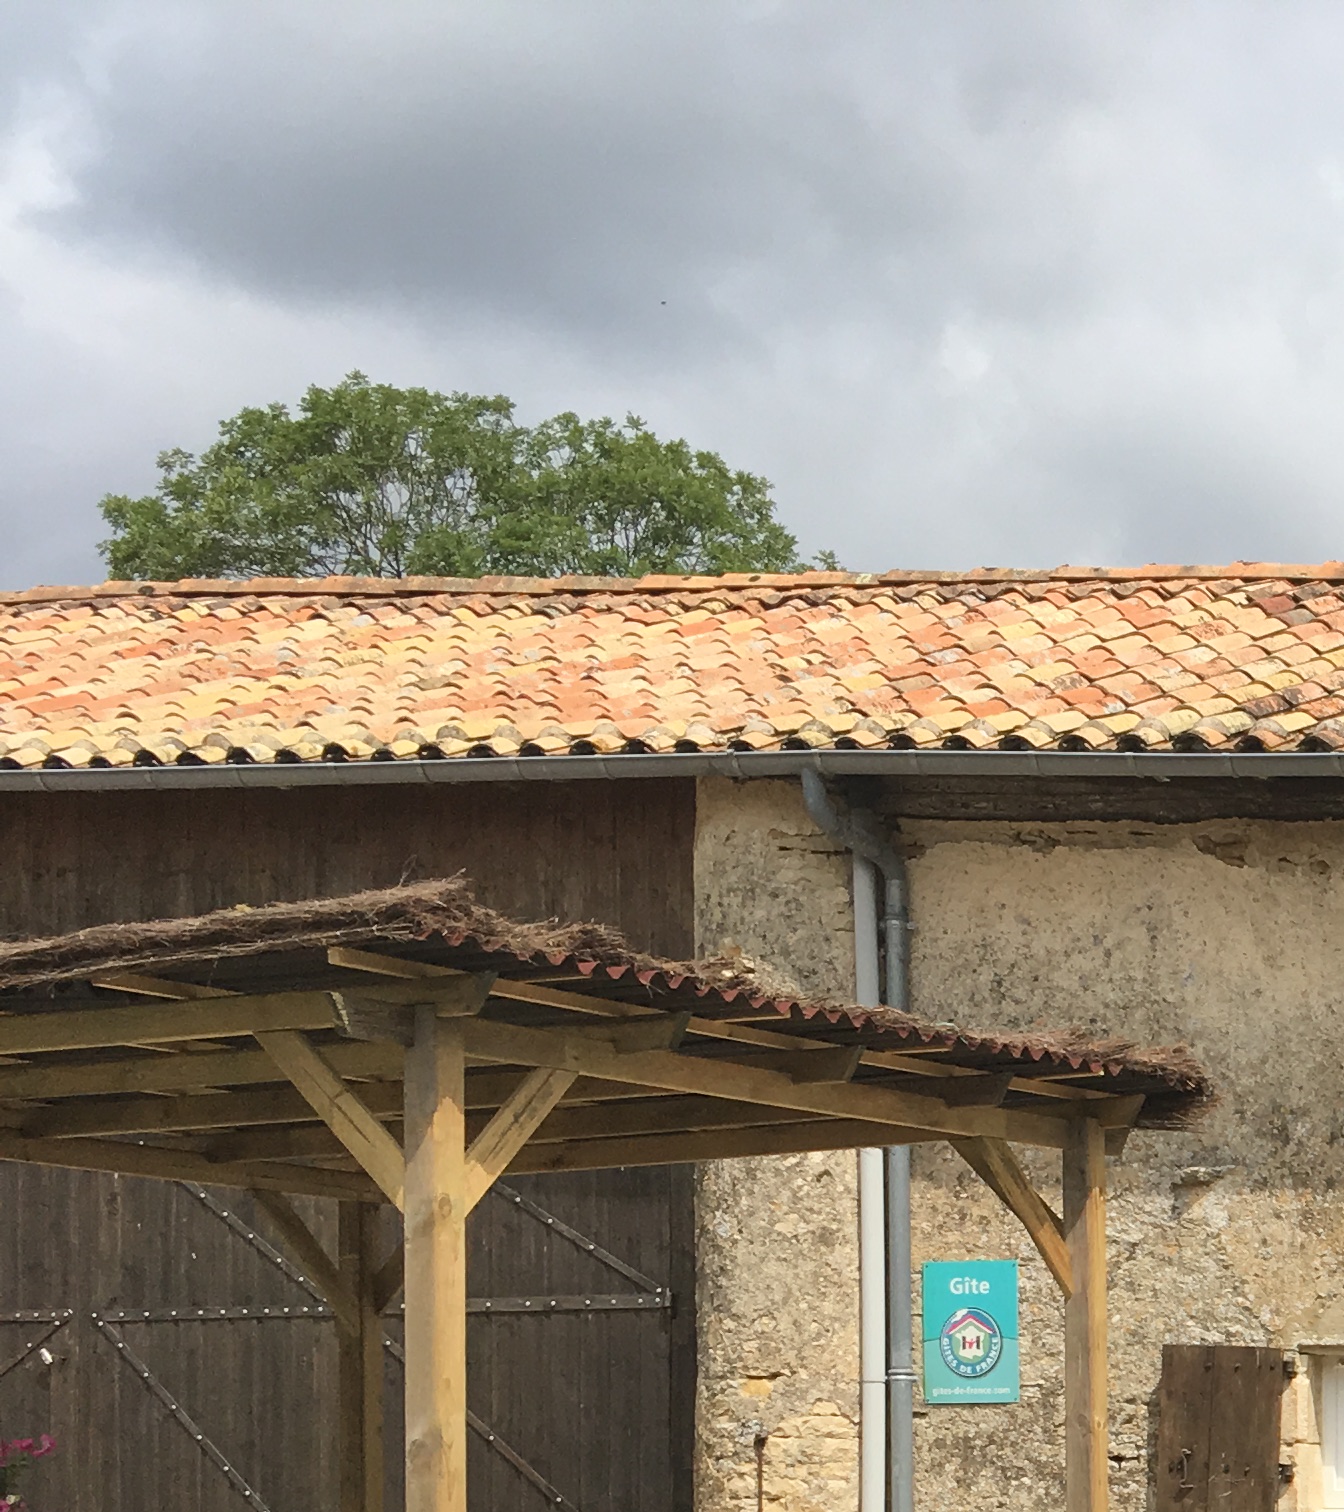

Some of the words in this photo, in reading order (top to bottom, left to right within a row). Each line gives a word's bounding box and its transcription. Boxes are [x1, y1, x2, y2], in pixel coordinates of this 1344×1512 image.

[949, 1277, 990, 1295] Gîte
[959, 1365, 973, 1374] DE
[976, 1337, 999, 1373] FRANCE
